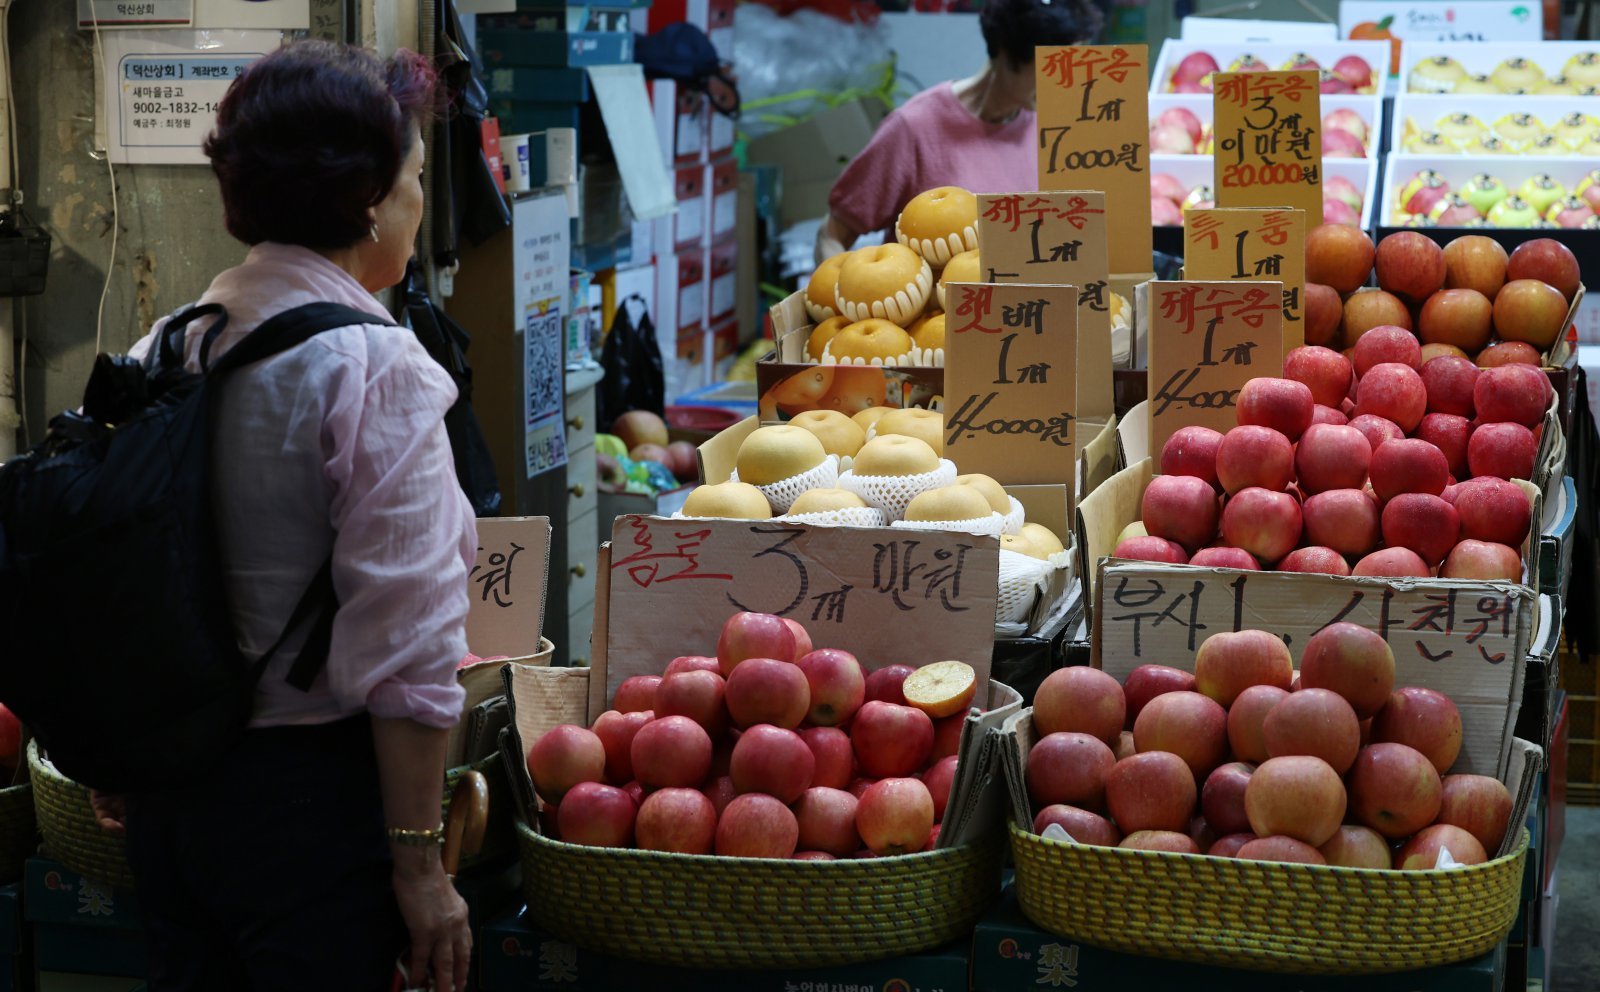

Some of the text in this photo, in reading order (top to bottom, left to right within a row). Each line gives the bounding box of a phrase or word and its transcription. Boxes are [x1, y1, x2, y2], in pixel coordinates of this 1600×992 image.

[117, 4, 155, 15] 덕신상회
[133, 64, 176, 78] 덕신상회
[191, 66, 229, 77] 계좌번호
[1042, 48, 1141, 88] 제수용
[133, 87, 184, 98] 새마을금고
[1076, 79, 1125, 122] 1개
[1217, 74, 1313, 107] 제수용
[133, 119, 158, 128] 예금주
[166, 119, 191, 128] 최정원
[1243, 96, 1302, 130] 3개
[982, 195, 1105, 232] 제수용
[1026, 219, 1083, 264] 1개
[1231, 230, 1285, 278] 1개
[1159, 287, 1281, 334] 제수용
[992, 333, 1051, 384] 1개
[1197, 316, 1258, 366] 1개
[467, 540, 525, 608] 원
[726, 526, 854, 624] 3개
[872, 539, 975, 611] 만원
[1112, 576, 1207, 657] 부사
[1035, 942, 1080, 987] 梨
